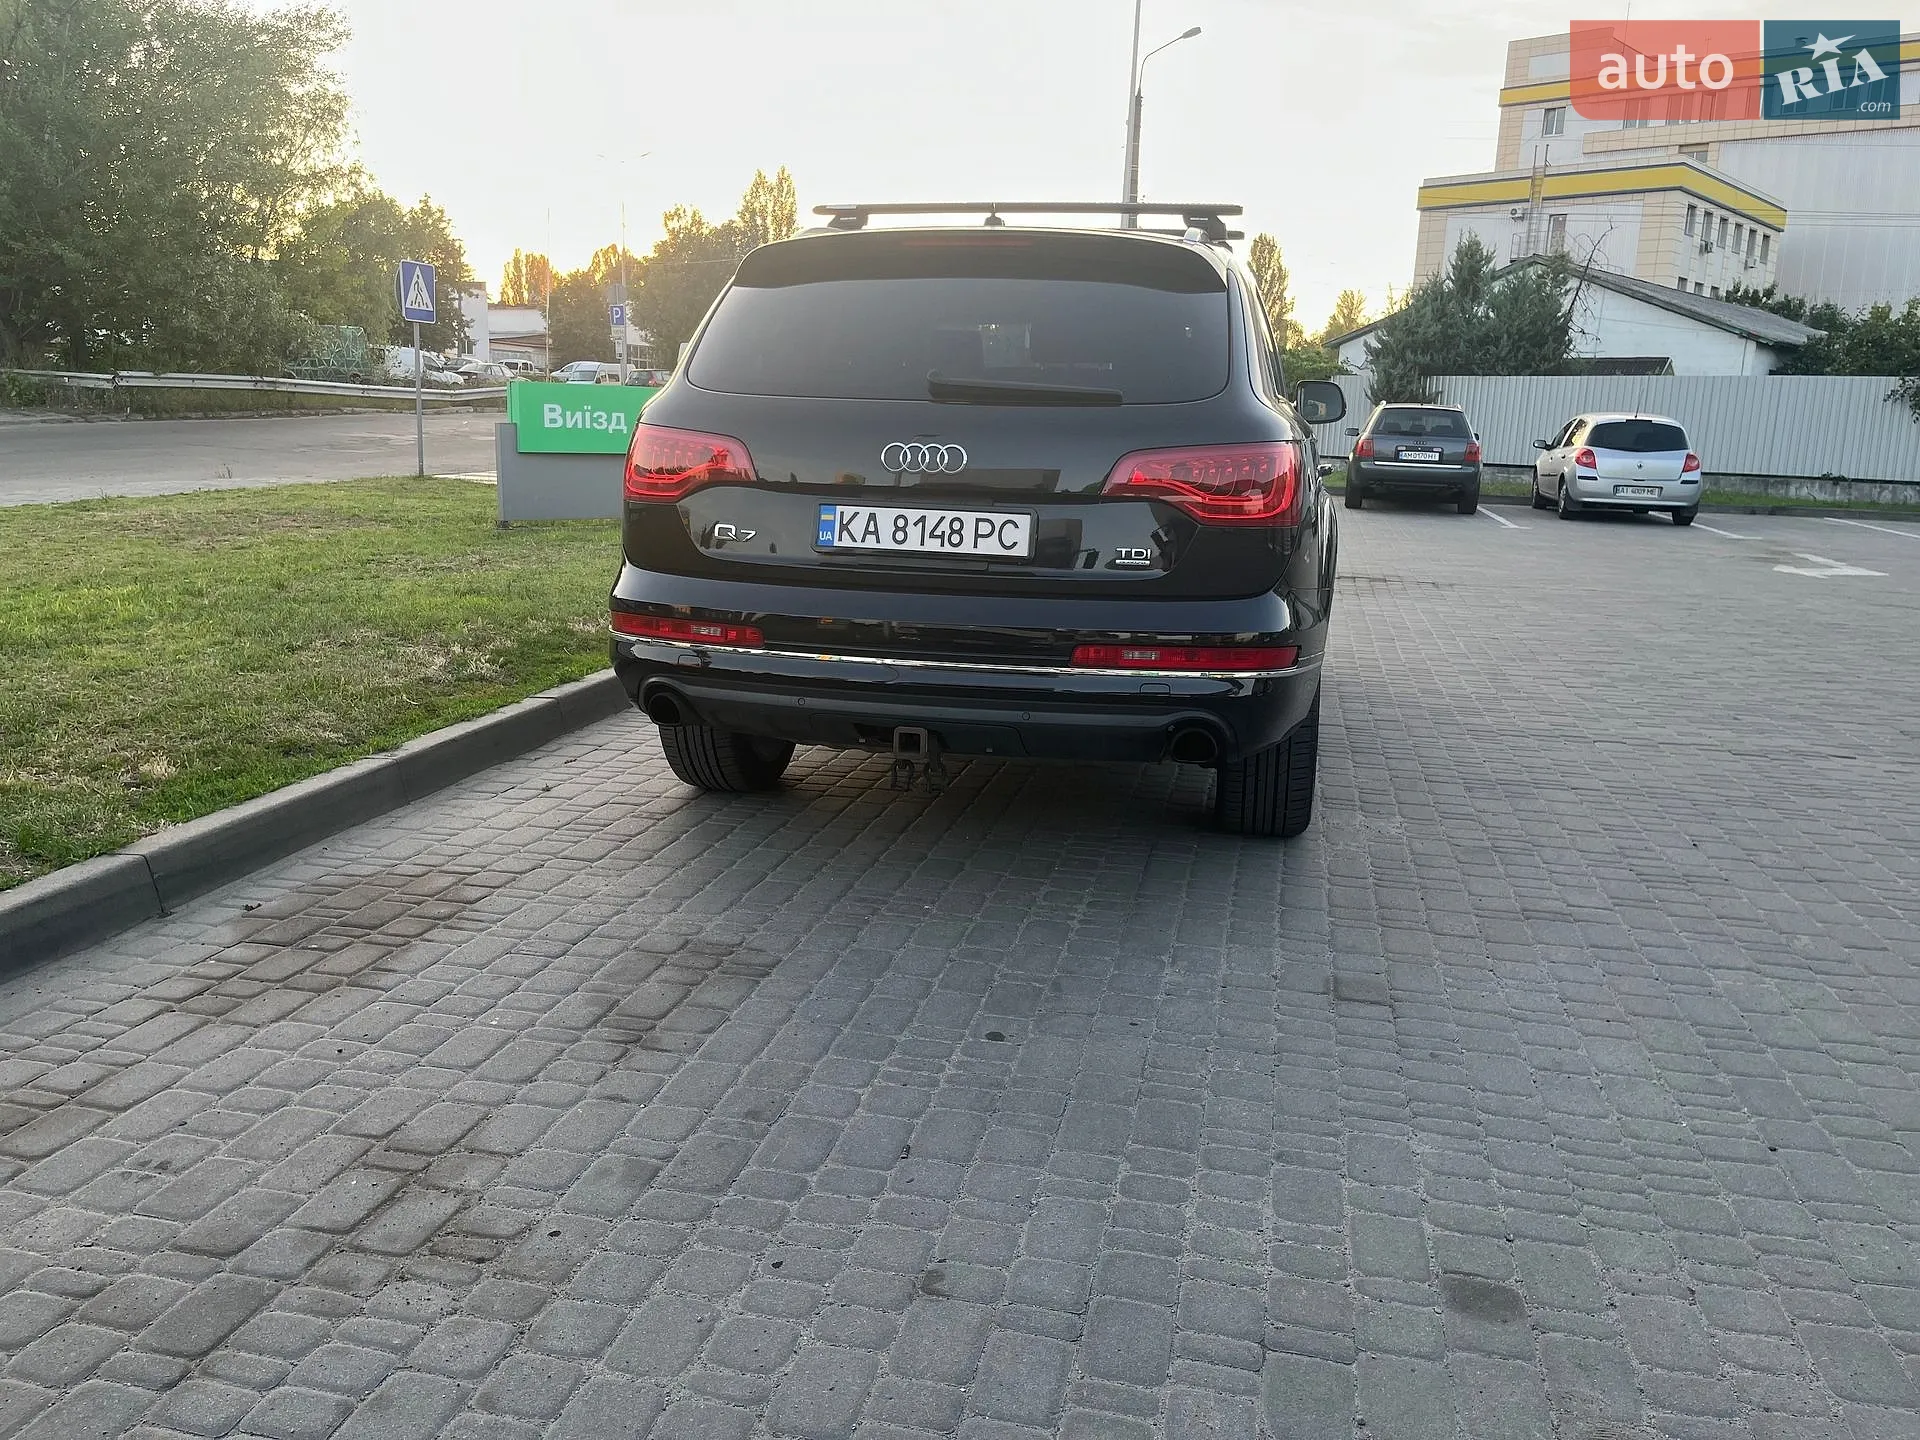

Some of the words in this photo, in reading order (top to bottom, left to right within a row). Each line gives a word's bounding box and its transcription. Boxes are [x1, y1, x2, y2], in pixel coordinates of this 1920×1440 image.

[612, 307, 621, 324] P
[543, 403, 628, 434] Виїзд
[819, 531, 832, 541] UA
[837, 511, 881, 544] KA
[891, 514, 965, 548] 8148
[972, 517, 1020, 551] PC
[1116, 547, 1152, 560] TDI
